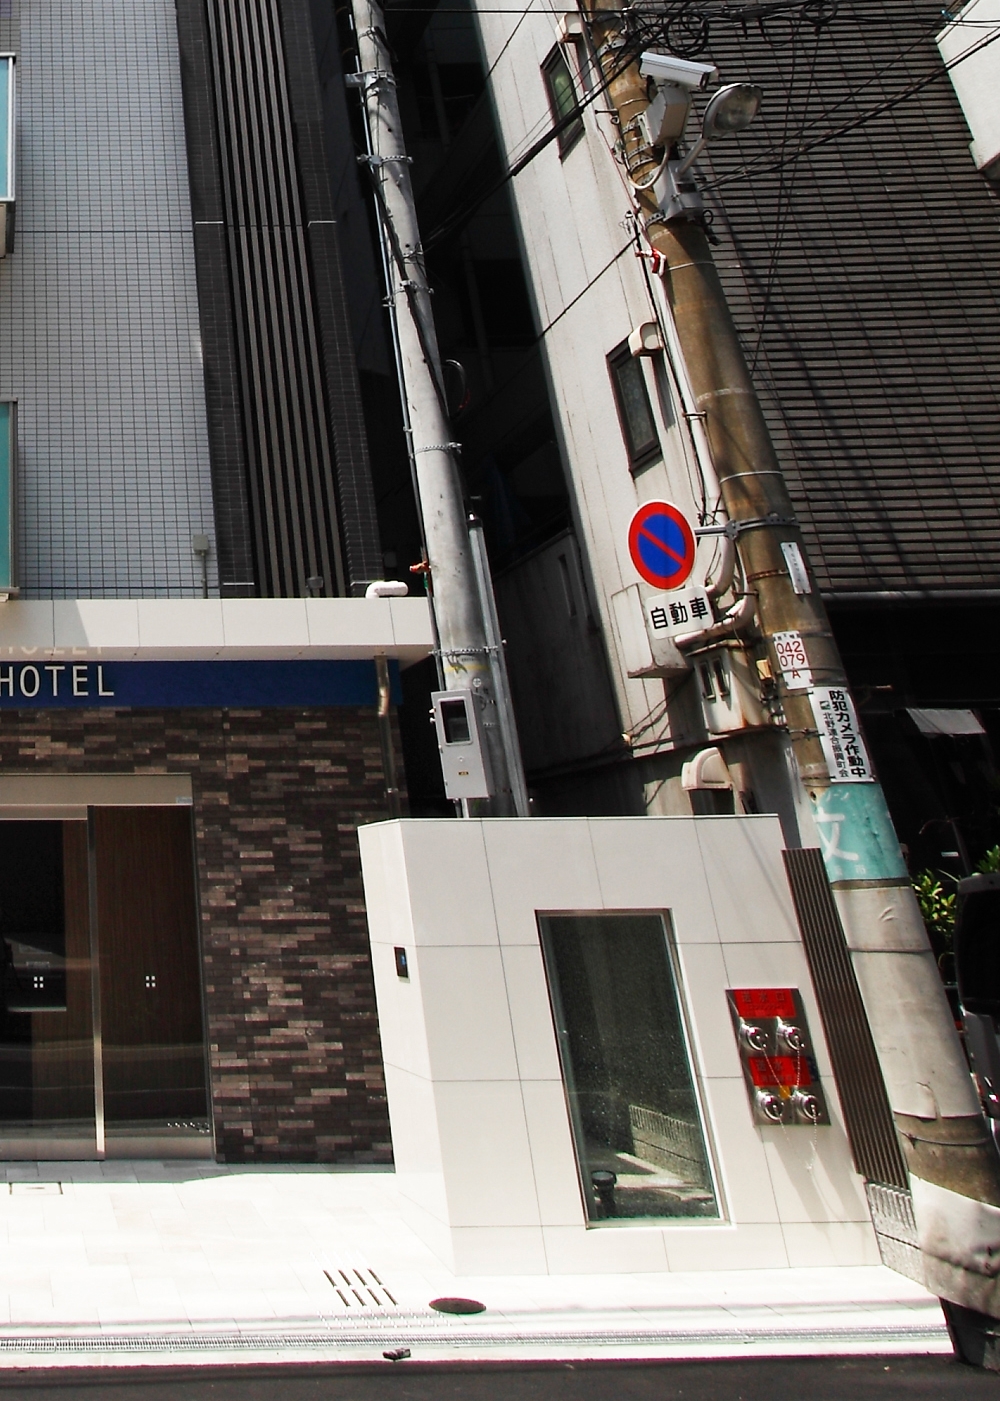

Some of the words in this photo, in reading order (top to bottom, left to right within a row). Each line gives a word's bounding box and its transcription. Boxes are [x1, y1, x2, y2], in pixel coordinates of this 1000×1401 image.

[650, 596, 708, 630] 自動車
[775, 640, 803, 655] 042
[779, 653, 806, 667] 079
[791, 666, 801, 680] A
[822, 711, 850, 778] 北野連合振興町会
[828, 689, 867, 778] 防犯カメラ作動中
